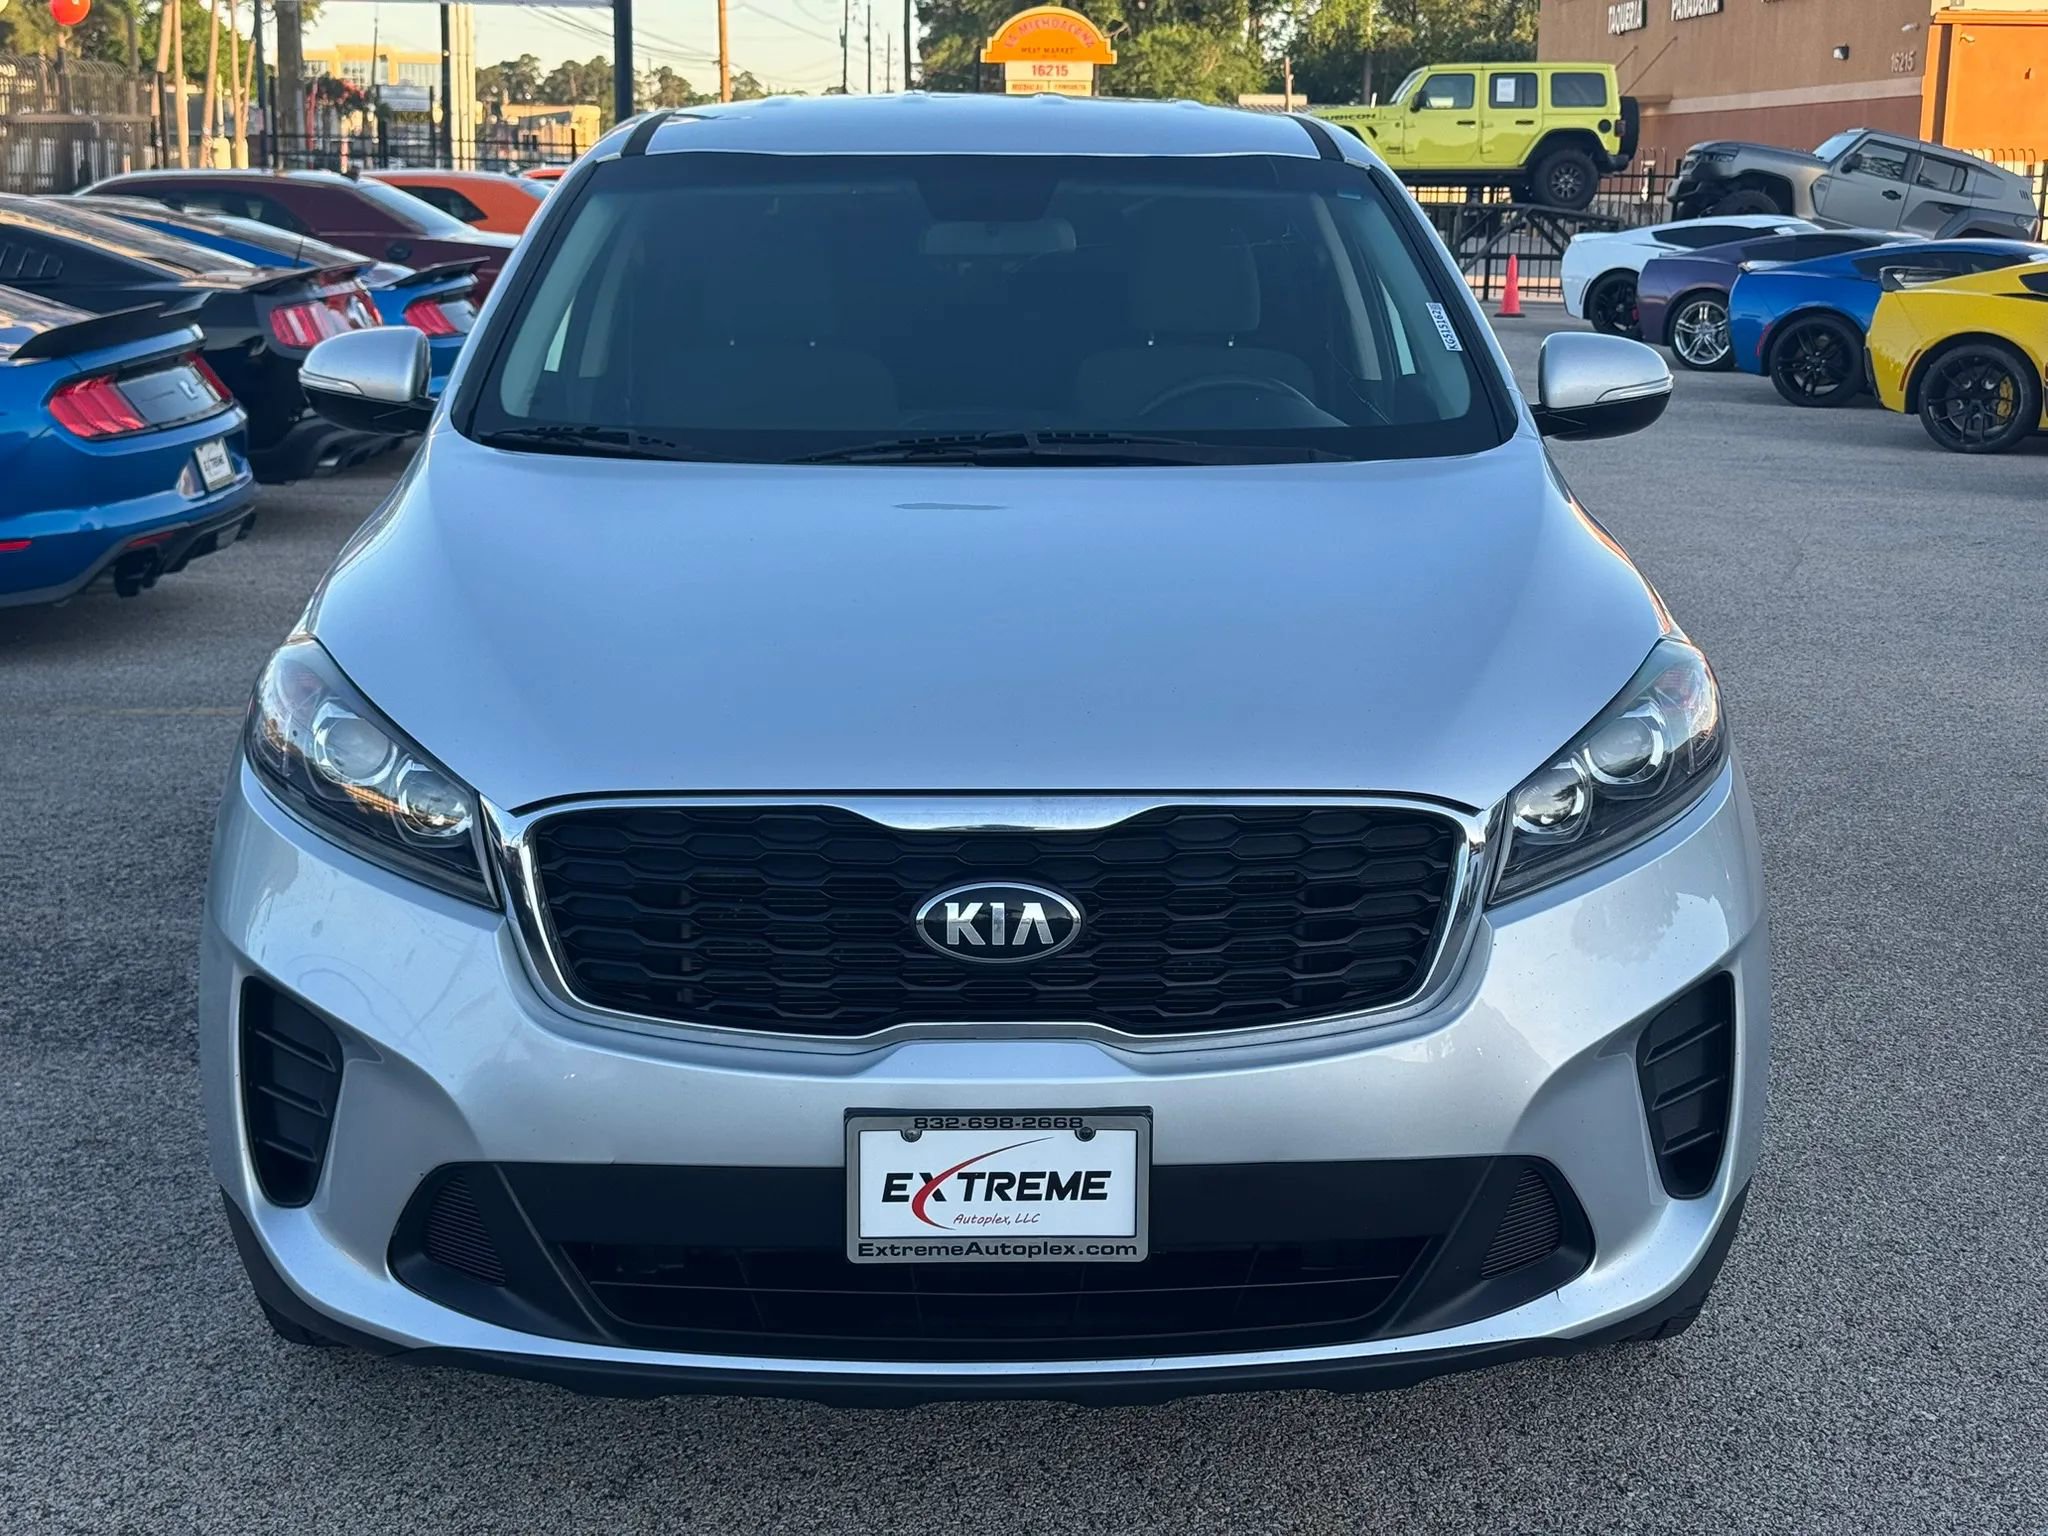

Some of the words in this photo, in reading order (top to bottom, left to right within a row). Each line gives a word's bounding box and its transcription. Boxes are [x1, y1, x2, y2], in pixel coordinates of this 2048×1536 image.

[1608, 0, 1643, 35] TAQUERIA
[1032, 65, 1069, 77] 16215
[1891, 50, 1915, 72] 16215
[945, 902, 1054, 946] KIA
[914, 1117, 1084, 1129] 832-698-2668
[881, 1170, 1112, 1203] EXTREME
[953, 1213, 1012, 1228] Autoplex,
[1014, 1213, 1041, 1225] LLC
[858, 1241, 1138, 1259] ExtremeAutoplex.com
